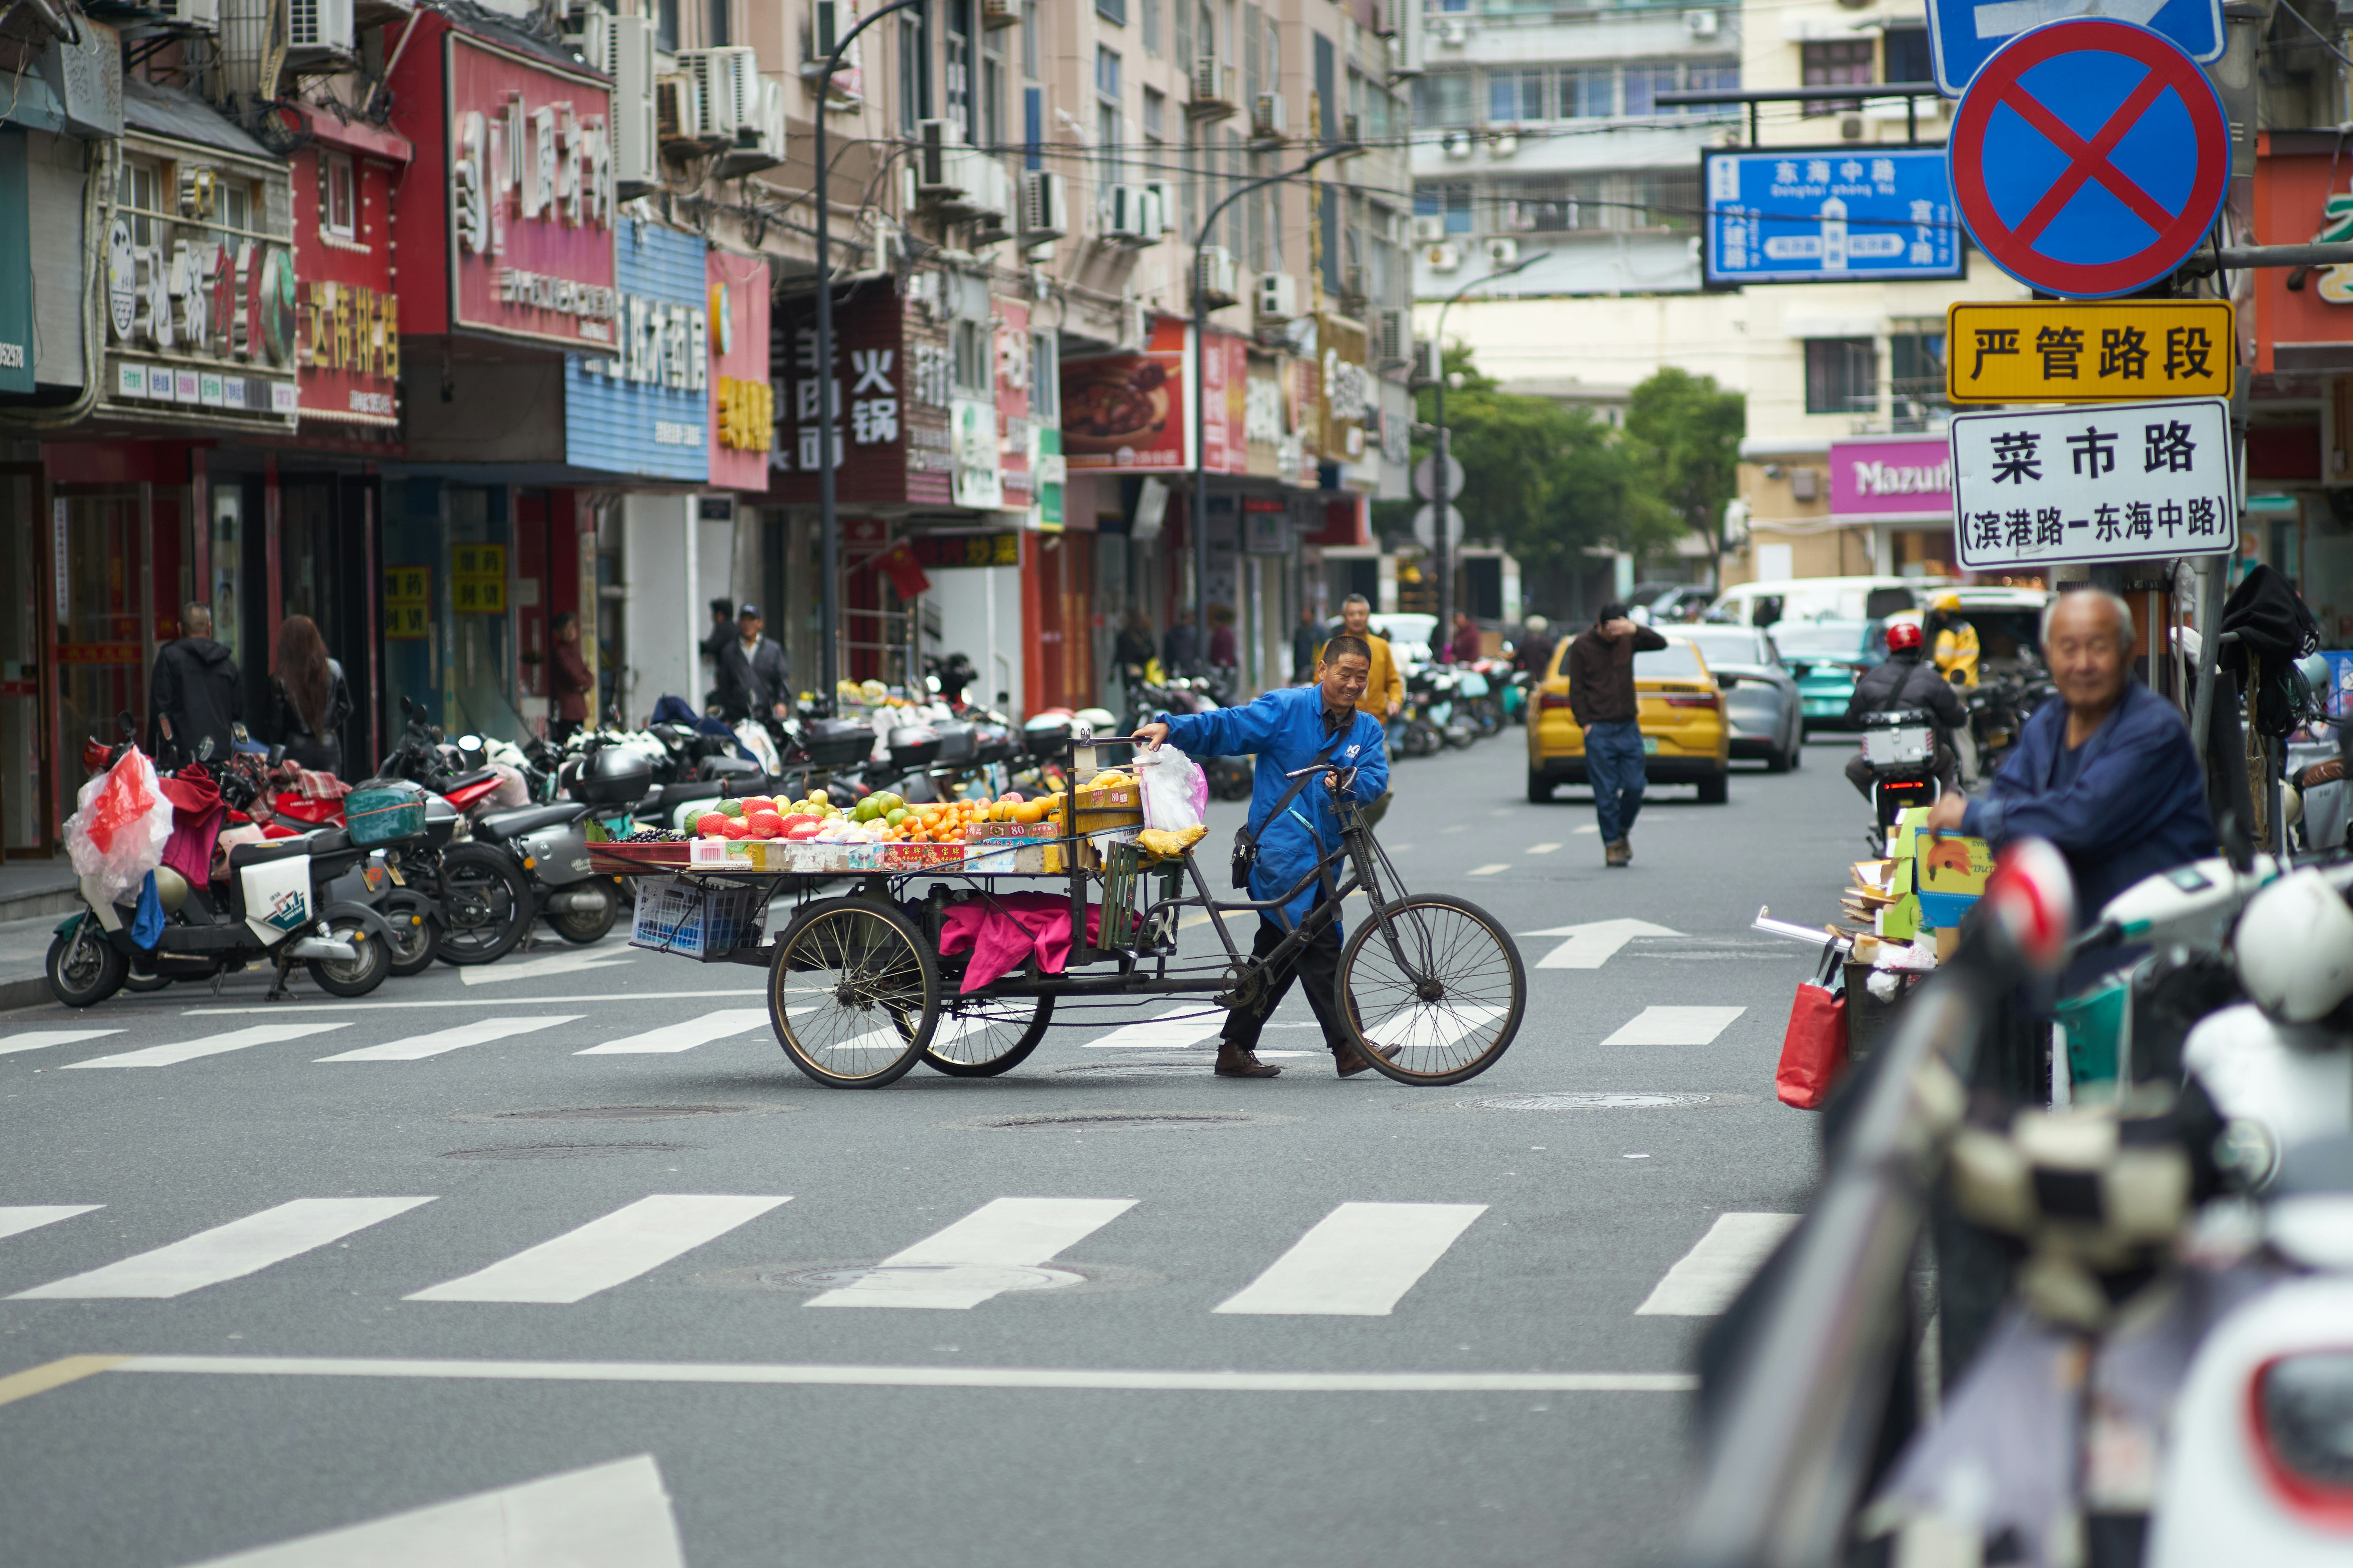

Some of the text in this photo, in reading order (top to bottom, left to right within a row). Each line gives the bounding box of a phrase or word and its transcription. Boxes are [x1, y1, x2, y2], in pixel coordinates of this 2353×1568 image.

[1970, 325, 2214, 380] 严管路段
[851, 349, 899, 444] 火锅
[1990, 420, 2197, 485] 菜市路
[1112, 793, 1119, 802] 80
[969, 825, 982, 836] 精品
[1011, 825, 1025, 835] 80
[903, 846, 921, 855] 宝牌
[941, 847, 960, 856] 宝牌
